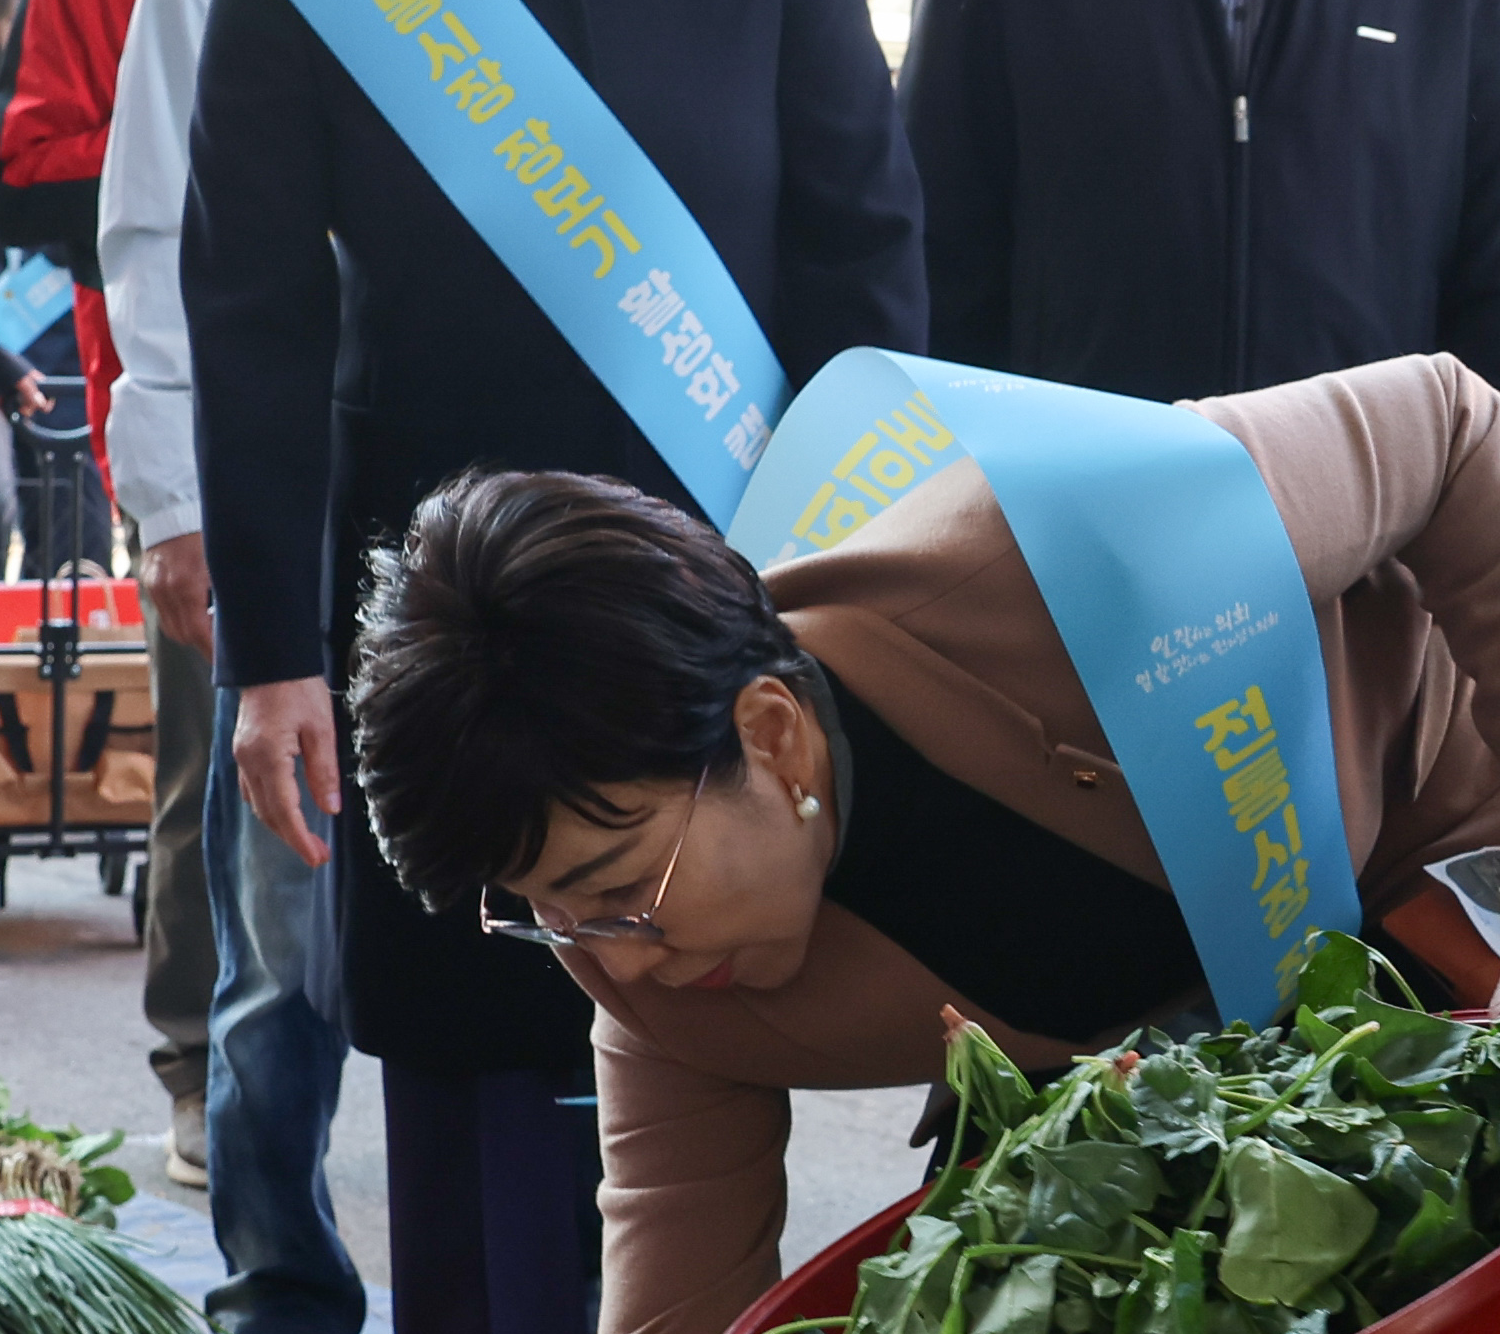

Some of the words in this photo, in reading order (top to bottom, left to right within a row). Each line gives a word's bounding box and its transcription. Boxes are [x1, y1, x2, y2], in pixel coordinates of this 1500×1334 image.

[493, 117, 642, 279] 장보기
[617, 268, 741, 421] 활성화
[1195, 684, 1310, 939] 전통시장
